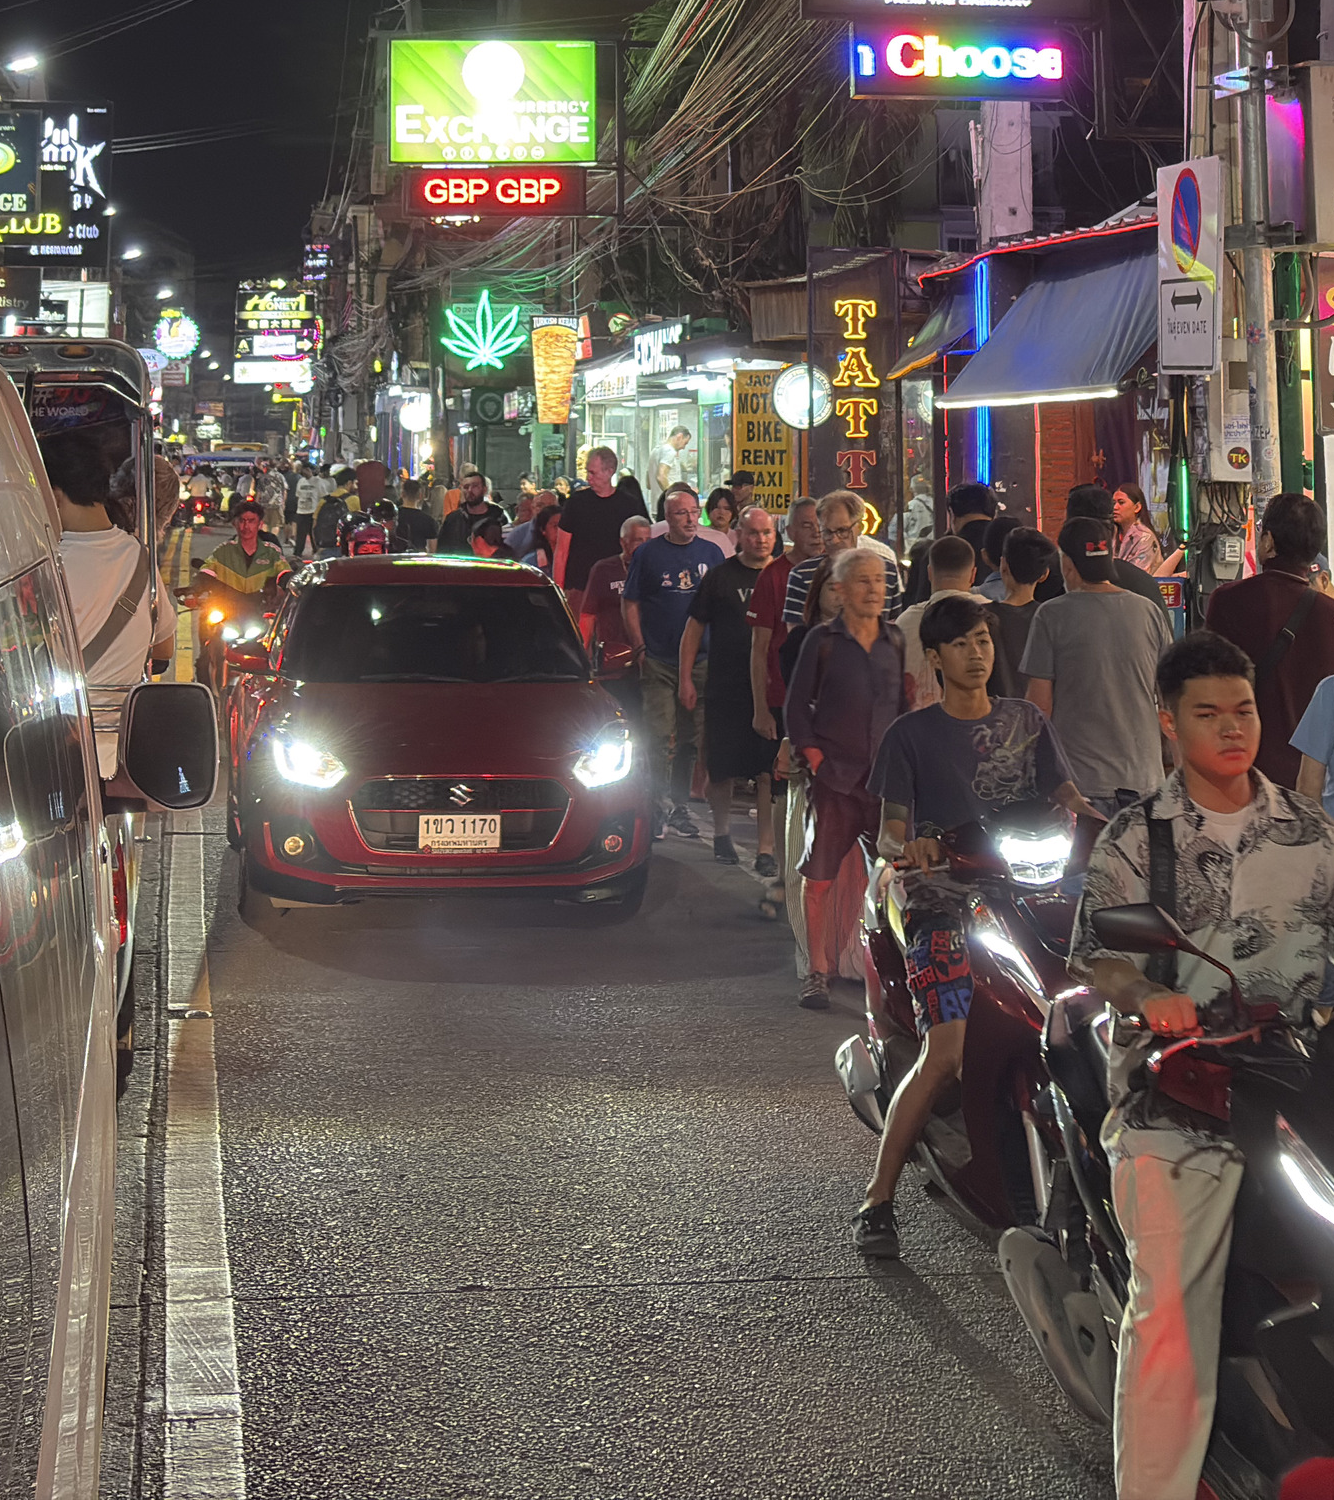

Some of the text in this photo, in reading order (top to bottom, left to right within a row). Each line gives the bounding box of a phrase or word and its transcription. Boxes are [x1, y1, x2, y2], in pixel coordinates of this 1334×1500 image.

[886, 34, 1063, 80] Choose
[509, 100, 589, 115] URRENCY
[424, 177, 561, 205] GBP GBP
[75, 223, 100, 240] Club
[1176, 320, 1191, 335] EVEN
[1192, 320, 1207, 334] DATE
[47, 407, 88, 417] WORLD
[738, 393, 777, 415] MOT
[746, 420, 783, 443] BIKE
[742, 449, 787, 466] RENT
[1229, 453, 1248, 464] TK
[753, 493, 791, 510] RVICE
[424, 818, 497, 835] 1ขว 1170
